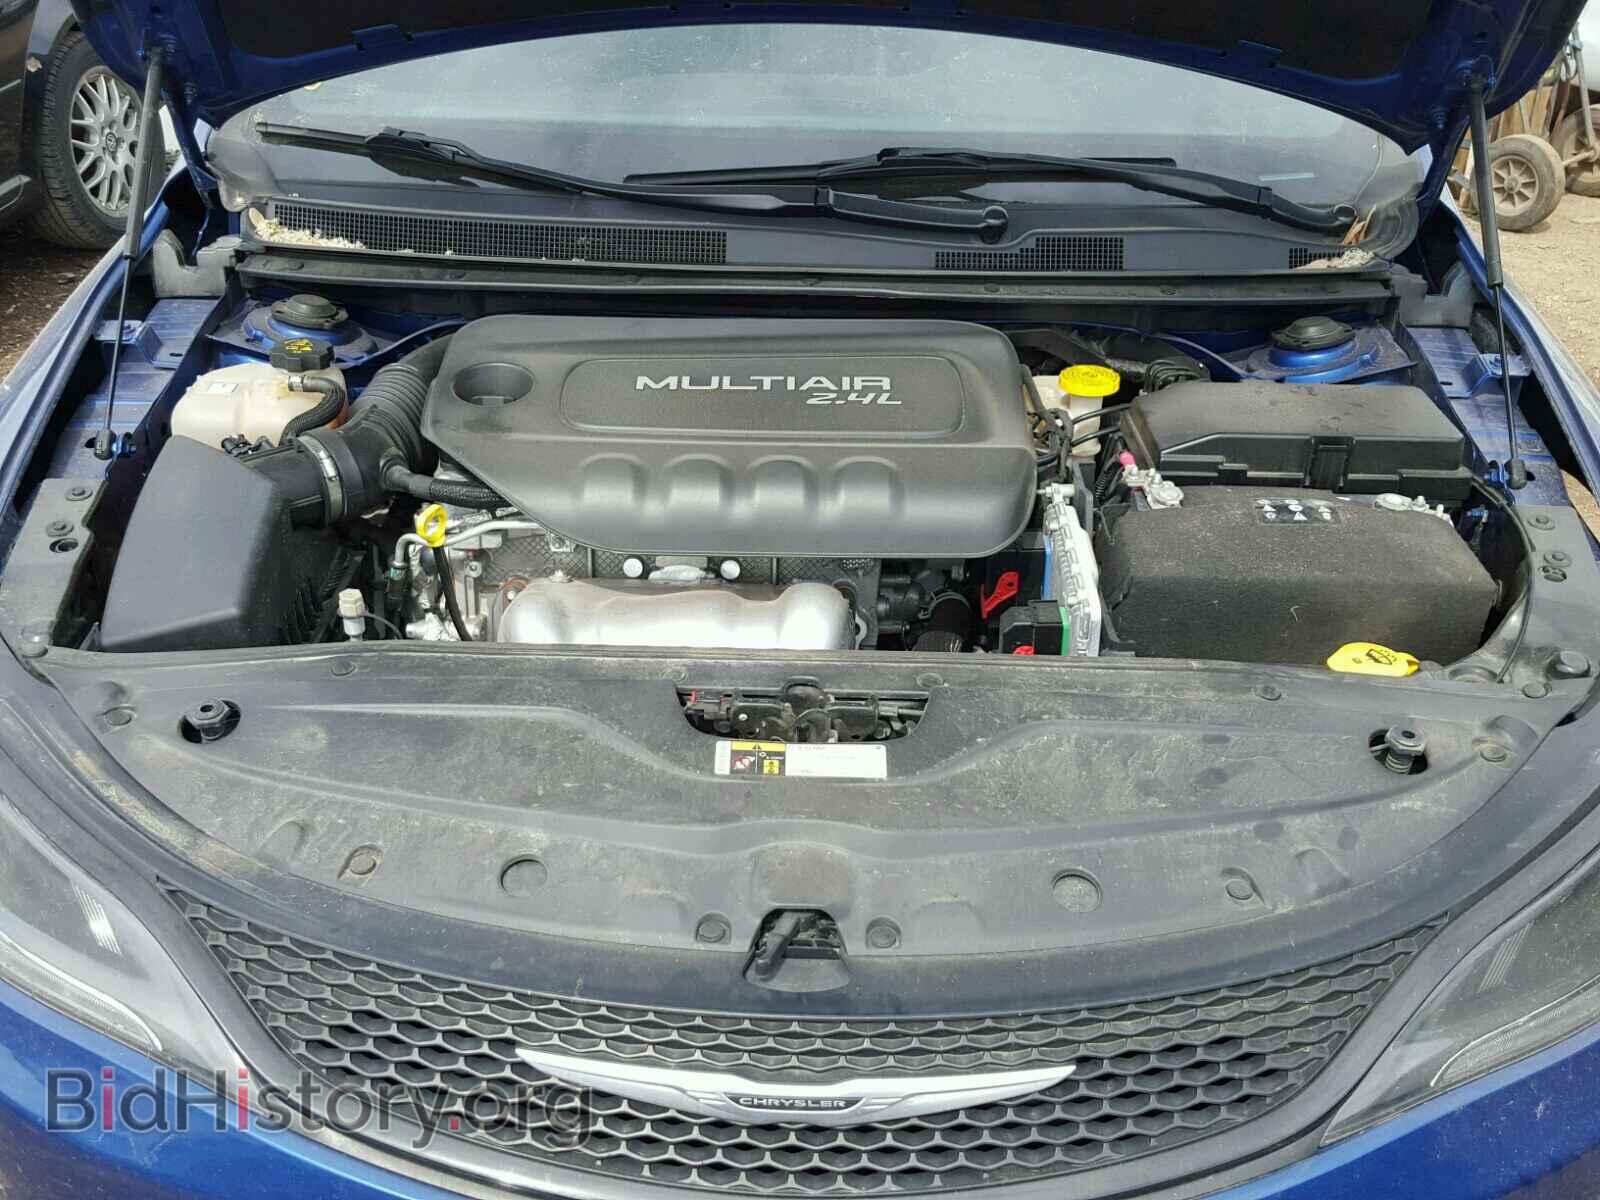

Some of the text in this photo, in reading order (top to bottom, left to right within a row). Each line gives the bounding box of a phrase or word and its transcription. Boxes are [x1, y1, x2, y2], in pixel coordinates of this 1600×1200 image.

[636, 376, 892, 390] MULTIAIR
[806, 392, 902, 405] 2.4L
[739, 1097, 847, 1108] CHRYSLER
